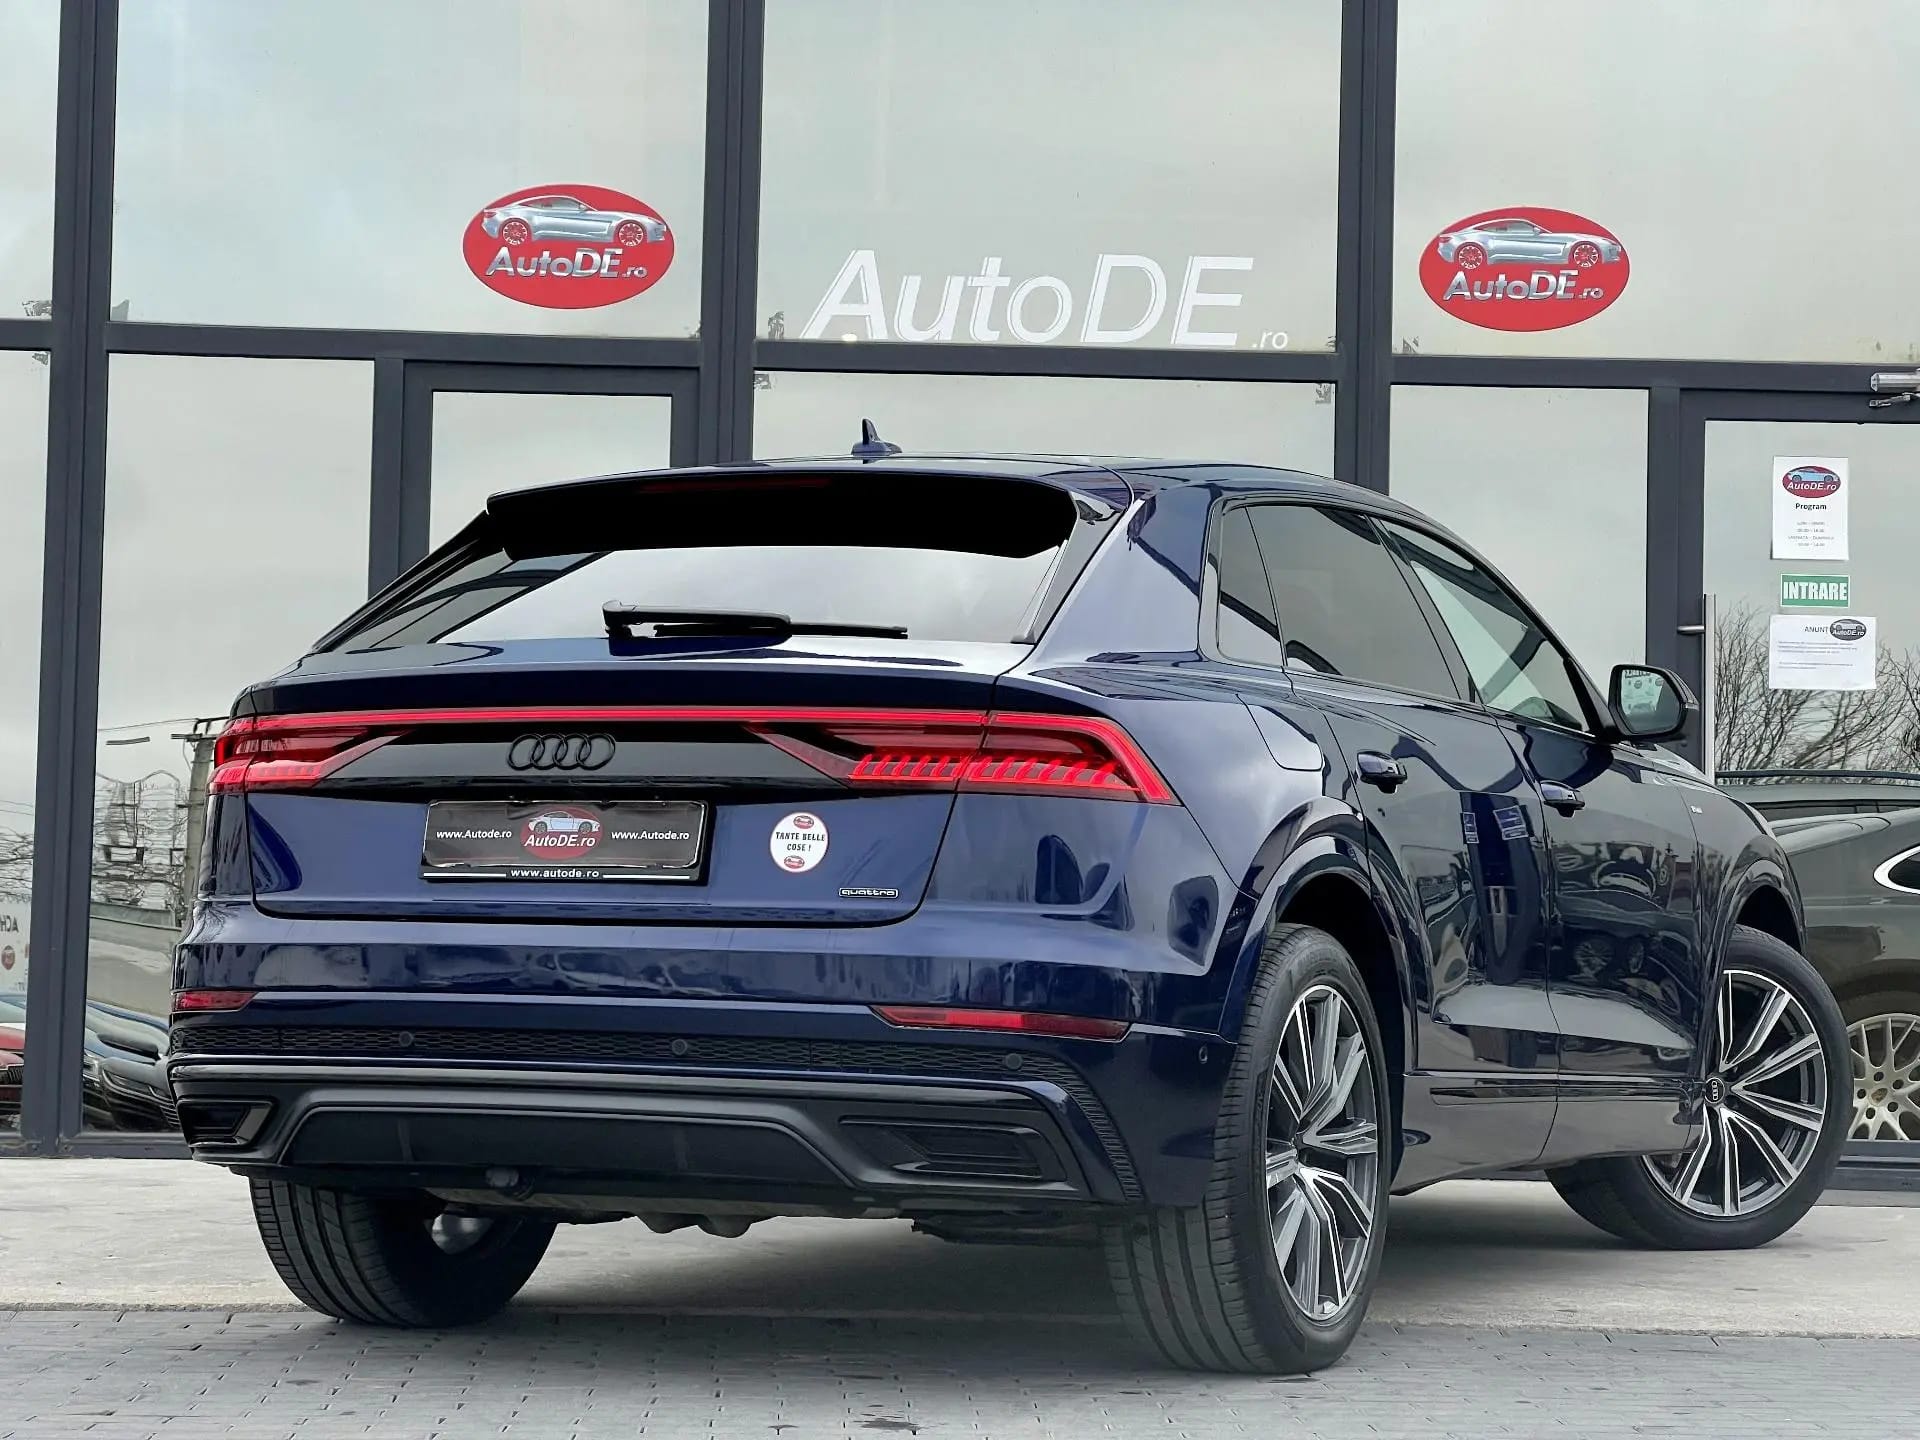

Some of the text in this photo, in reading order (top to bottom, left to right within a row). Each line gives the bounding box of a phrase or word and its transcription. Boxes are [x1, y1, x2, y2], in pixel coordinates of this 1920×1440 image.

[1786, 481, 1837, 492] AutoDE.ro
[1795, 502, 1827, 511] Program
[1783, 581, 1848, 601] INTRARE
[436, 828, 512, 839] www.Autode.ro
[611, 830, 690, 840] www.Autode.ro
[775, 831, 825, 841] TANTE BELLE
[524, 833, 596, 848] AutoDE.ro
[786, 843, 806, 852] COSE
[510, 868, 600, 879] www.autode.ro
[841, 889, 896, 897] quattro
